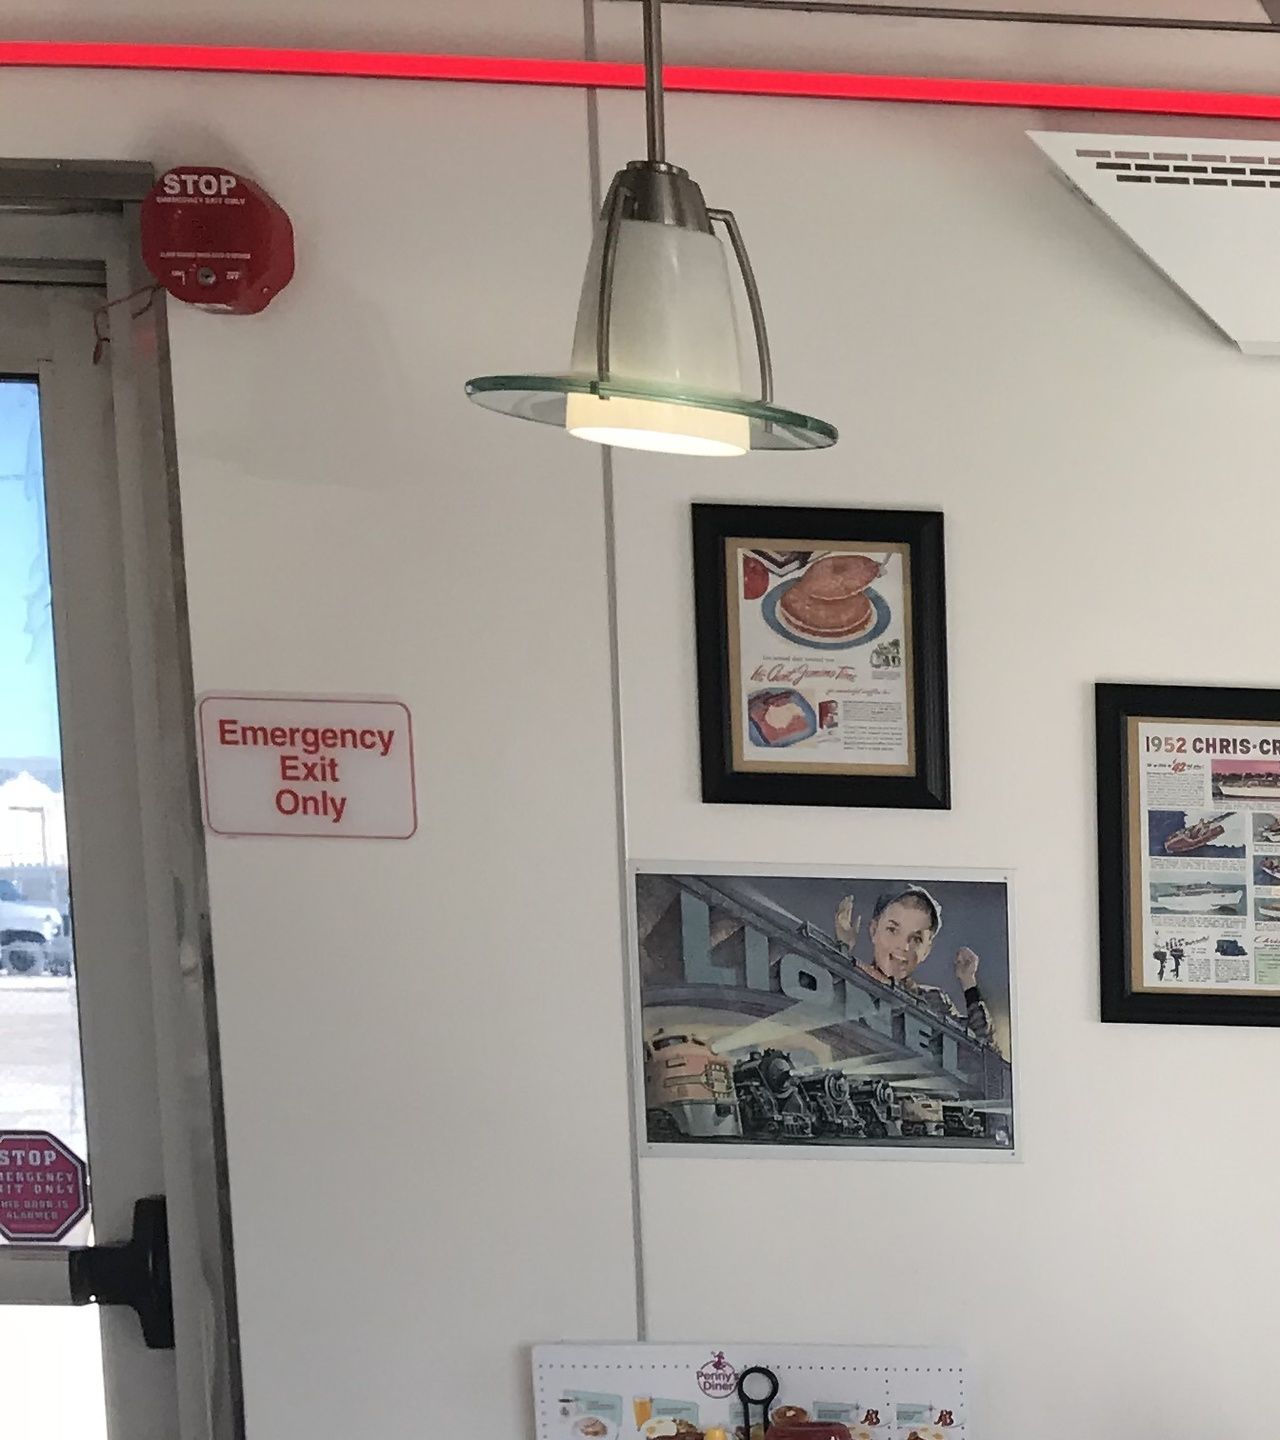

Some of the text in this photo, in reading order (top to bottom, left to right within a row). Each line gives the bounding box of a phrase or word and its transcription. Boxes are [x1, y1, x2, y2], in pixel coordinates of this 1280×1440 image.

[163, 173, 237, 195] STOP
[218, 719, 395, 757] Emergency
[1145, 735, 1187, 754] 1952
[280, 755, 340, 783] Exit
[275, 788, 347, 823] Only
[681, 889, 969, 1084] LIONEL
[0, 1150, 57, 1166] STOP
[696, 1370, 740, 1384] Penny's
[703, 1380, 735, 1392] Diner
